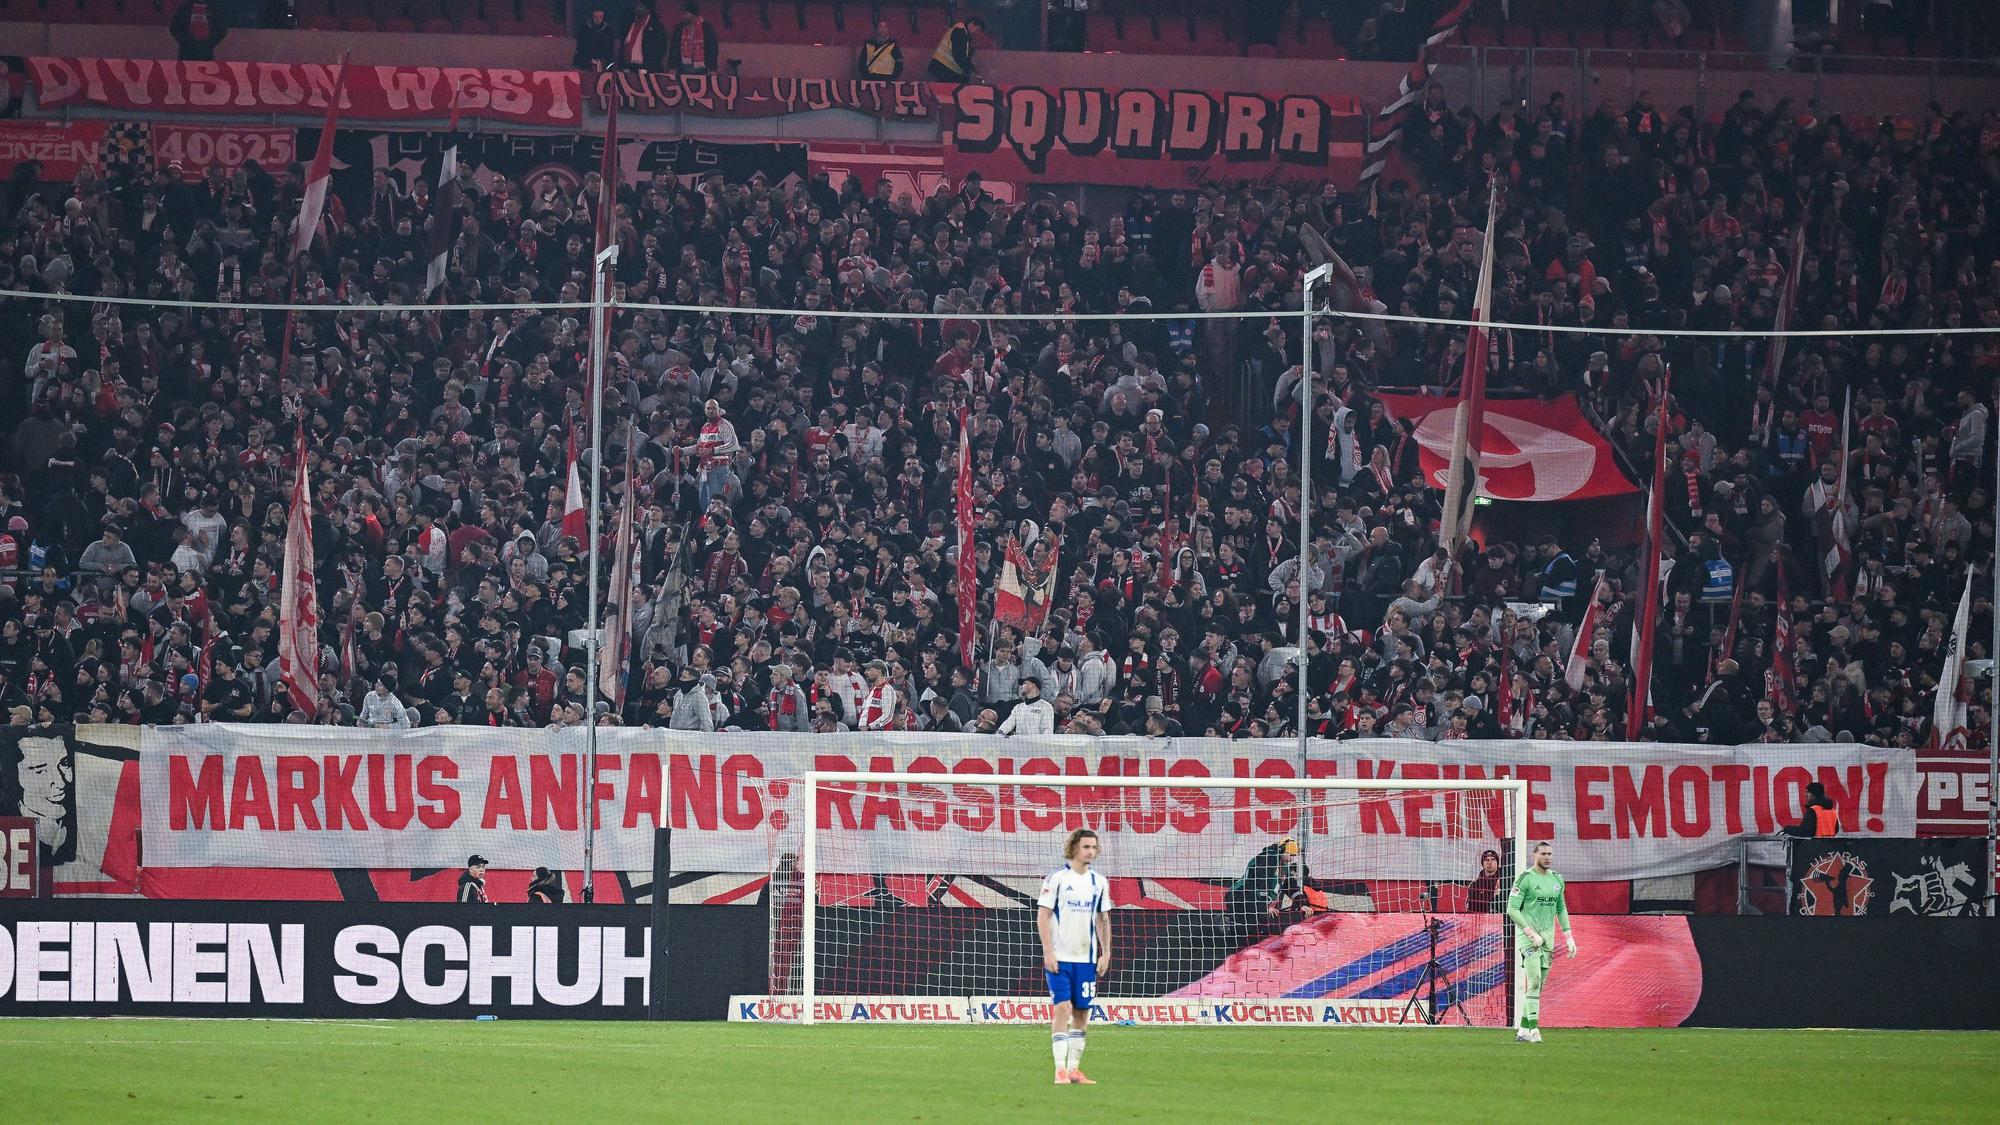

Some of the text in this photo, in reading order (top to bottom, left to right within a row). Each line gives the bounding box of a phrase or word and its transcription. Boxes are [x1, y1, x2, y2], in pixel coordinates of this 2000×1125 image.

[28, 57, 580, 118] DIVISION WEST
[597, 70, 928, 116] ANGRY YOUTH
[954, 84, 1326, 173] SQUADRA
[158, 131, 291, 167] 40625
[169, 753, 1889, 840] MARKUS ANFANG: RASSISMUS IST KEINE EMOTION!
[1810, 851, 1867, 870] ULTRAS
[333, 924, 650, 1005] SCHUH
[1081, 981, 1096, 998] 35
[740, 1000, 960, 1021] KÜCHEN AKTUELL
[981, 1000, 1196, 1022] KÜCH AKTUELL
[1215, 1002, 1427, 1023] KÜCHEN AKTUELL
